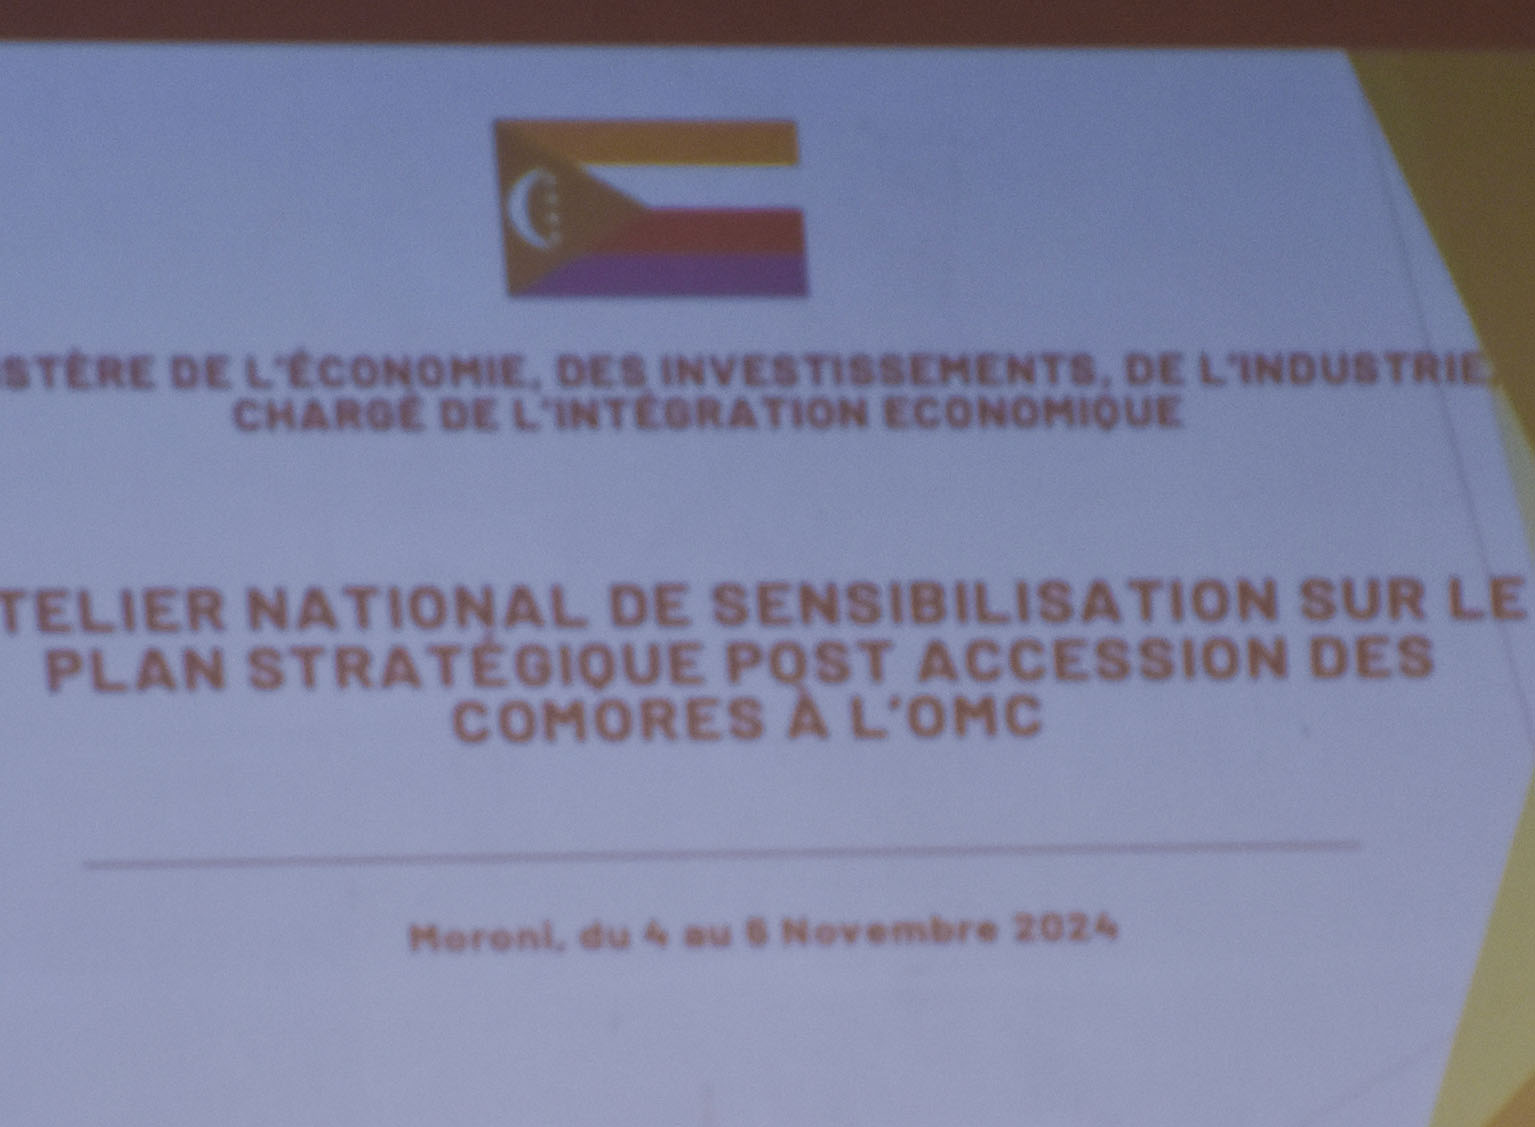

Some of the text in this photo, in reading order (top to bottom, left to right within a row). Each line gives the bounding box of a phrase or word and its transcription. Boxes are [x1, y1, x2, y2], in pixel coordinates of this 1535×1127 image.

[171, 355, 232, 389] DE
[557, 354, 651, 389] DES
[661, 353, 1113, 392] INVESTISSEMENTS,
[1126, 352, 1184, 387] DE
[232, 391, 1184, 432] CHARGÉ DE L'INTÉGRATION ECONOMIQUE
[247, 585, 588, 634] NATIONAL
[609, 584, 691, 629] DE
[711, 579, 1278, 627] SENSIBILISATION
[1299, 577, 1426, 623] SUR
[1449, 576, 1528, 622] LE
[45, 635, 1437, 695] PLAN STRATÉGIQUE POST ACCESSION DES
[452, 684, 1045, 744] COMORES À L'OMC
[408, 919, 565, 952] Moroni,
[579, 919, 631, 948] du
[644, 918, 667, 946] 4
[683, 923, 731, 947] au
[781, 914, 998, 945] Novembre
[1014, 910, 1117, 941] 2024
